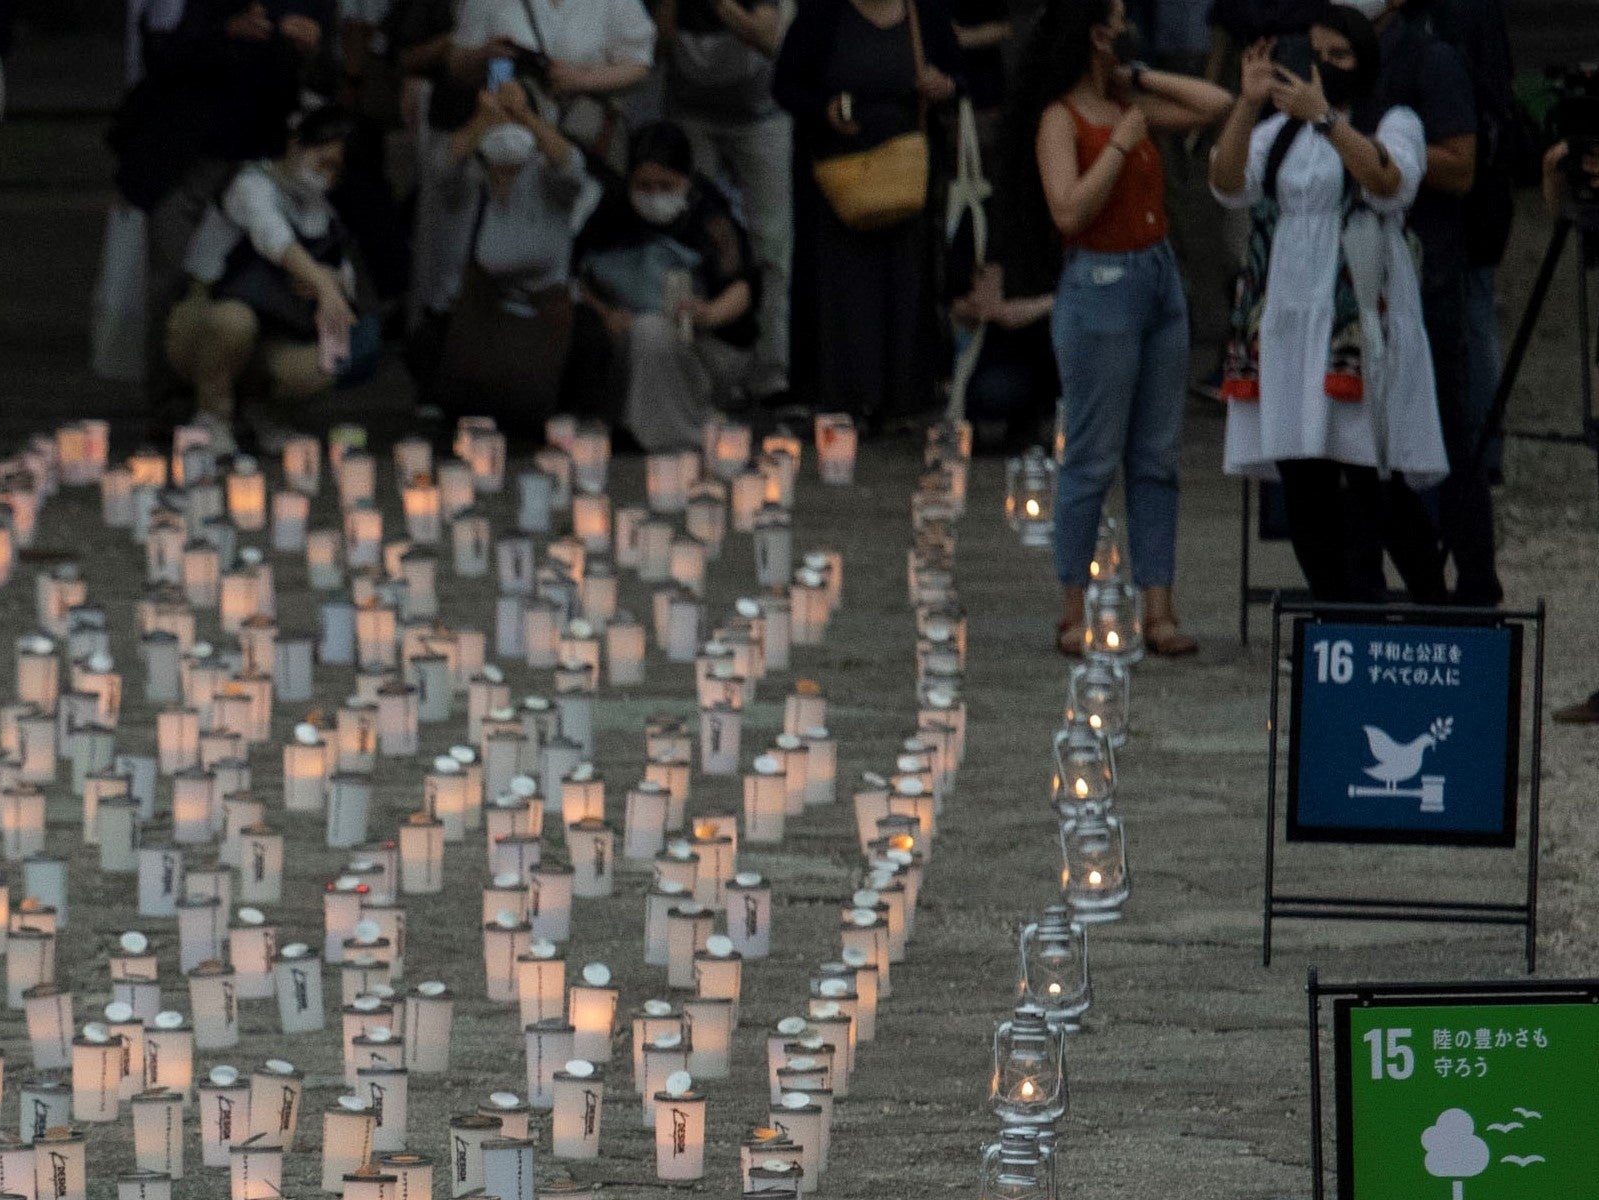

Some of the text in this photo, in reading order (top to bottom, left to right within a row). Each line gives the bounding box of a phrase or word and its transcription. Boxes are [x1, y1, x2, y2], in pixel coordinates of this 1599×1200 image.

[1313, 640, 1354, 684] 16
[1367, 641, 1462, 663] 平和と公正を
[1367, 666, 1461, 686] すべての人に
[1433, 1028, 1548, 1050] 陸の豊かさも
[1363, 1028, 1415, 1080] 15
[1434, 1056, 1489, 1078] 守ろう
